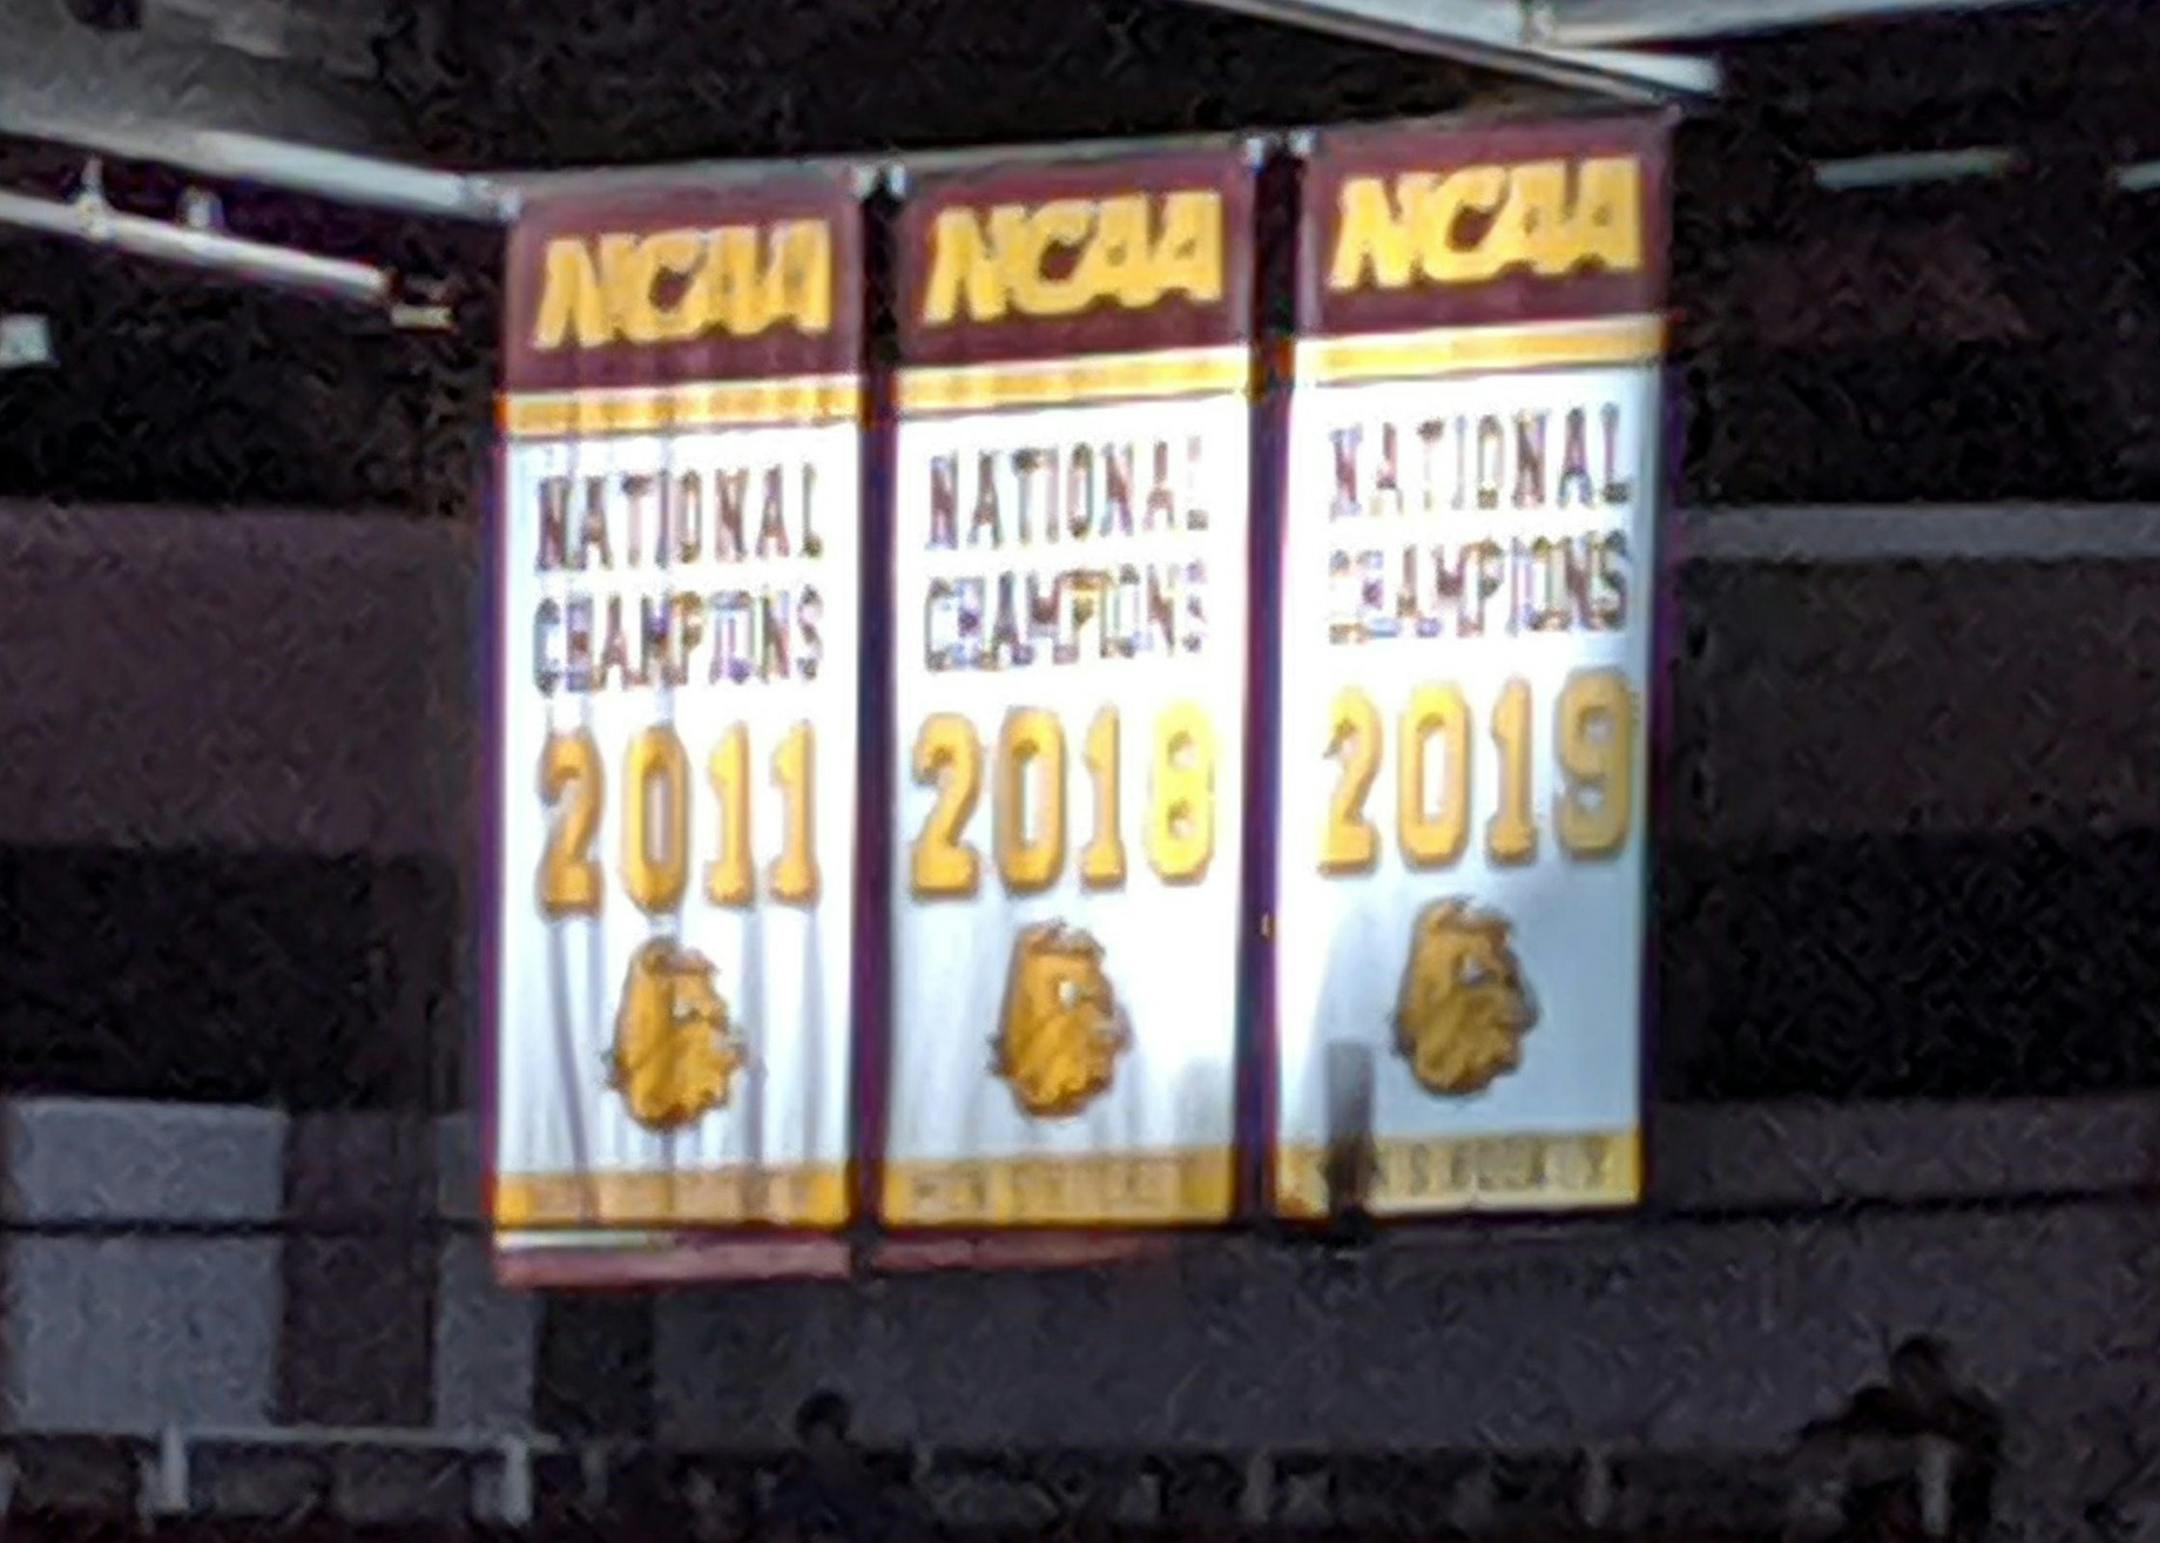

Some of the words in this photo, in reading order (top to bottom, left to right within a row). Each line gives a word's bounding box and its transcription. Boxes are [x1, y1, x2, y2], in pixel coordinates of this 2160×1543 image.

[533, 219, 832, 348] NCAA
[925, 191, 1222, 325] NCAA
[1330, 157, 1640, 292] NCAA
[536, 464, 822, 571] NATIONAL
[926, 437, 1208, 550] NATIONAL
[1329, 403, 1630, 521] NATIONAL
[533, 586, 824, 694] CHAMPIONS
[925, 560, 1209, 672] CHAMPIONS
[1329, 530, 1627, 645] CHAMPIONS
[536, 720, 820, 918] 2011
[911, 702, 1215, 898] 2018
[1317, 670, 1634, 876] 2019
